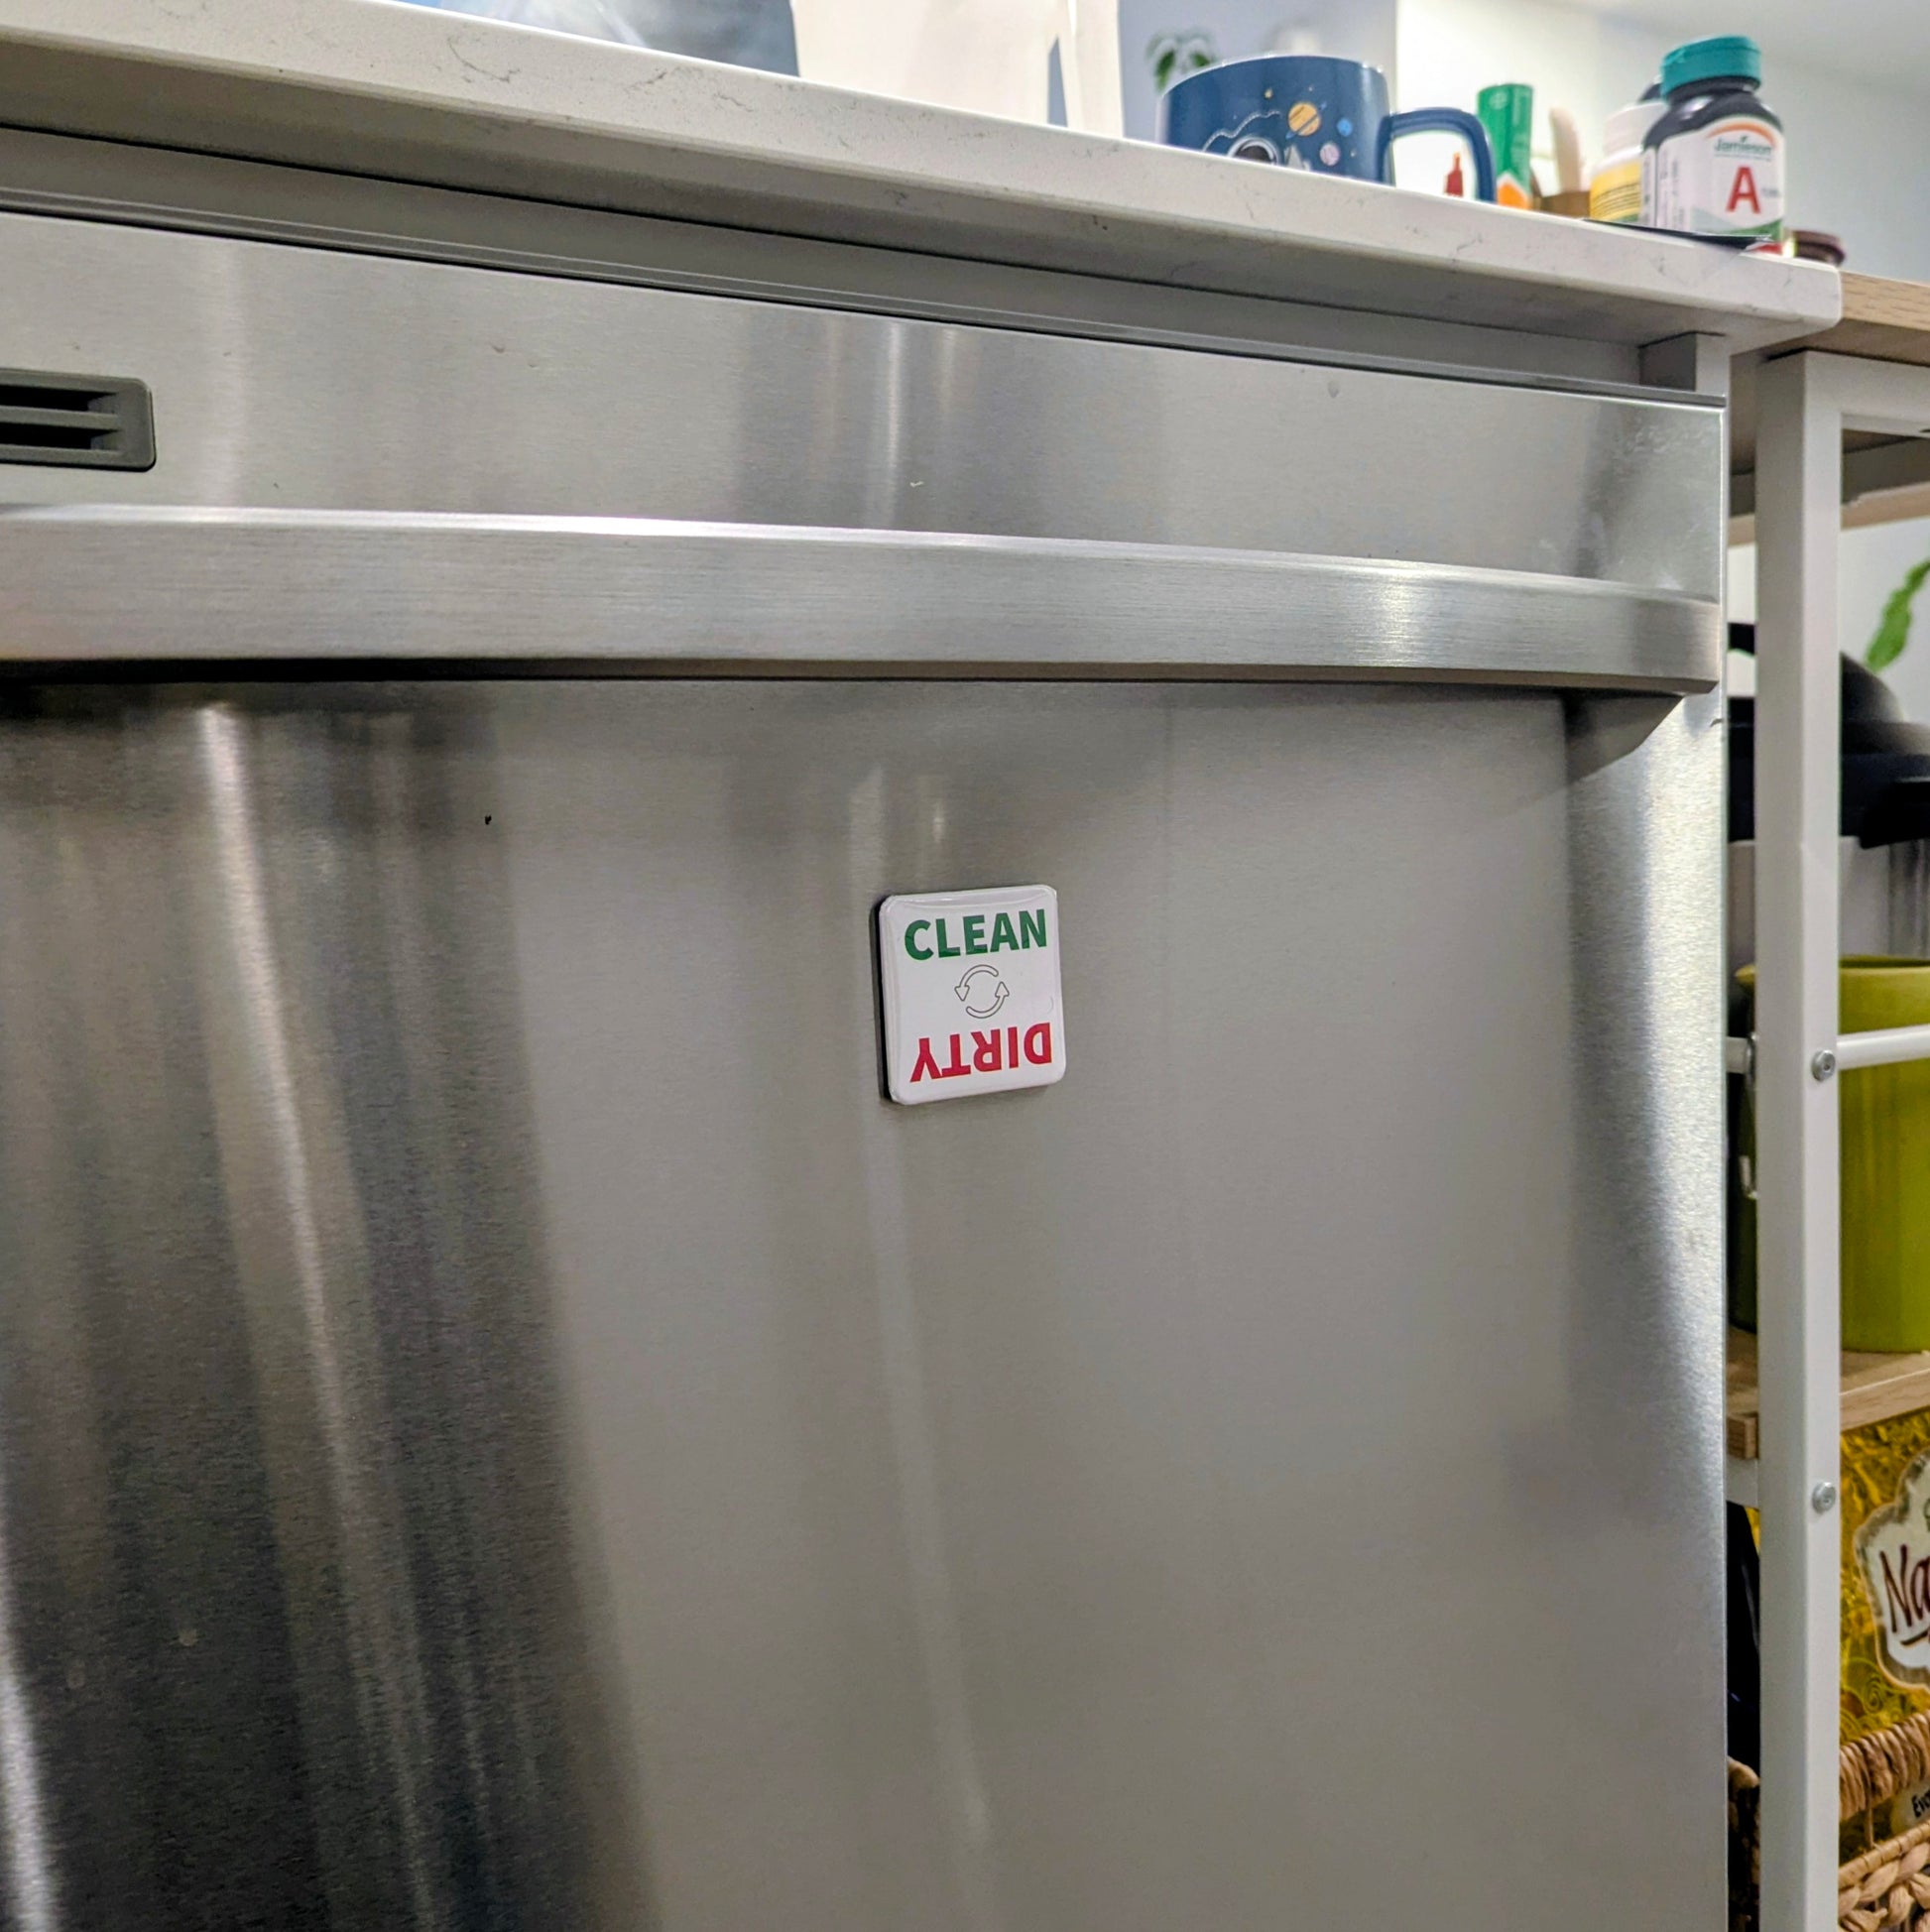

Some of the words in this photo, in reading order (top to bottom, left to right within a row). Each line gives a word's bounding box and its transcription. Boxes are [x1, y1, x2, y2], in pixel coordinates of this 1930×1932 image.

[1726, 166, 1761, 214] A
[905, 908, 1047, 960] CLEAN
[909, 1023, 1052, 1083] DIRTY
